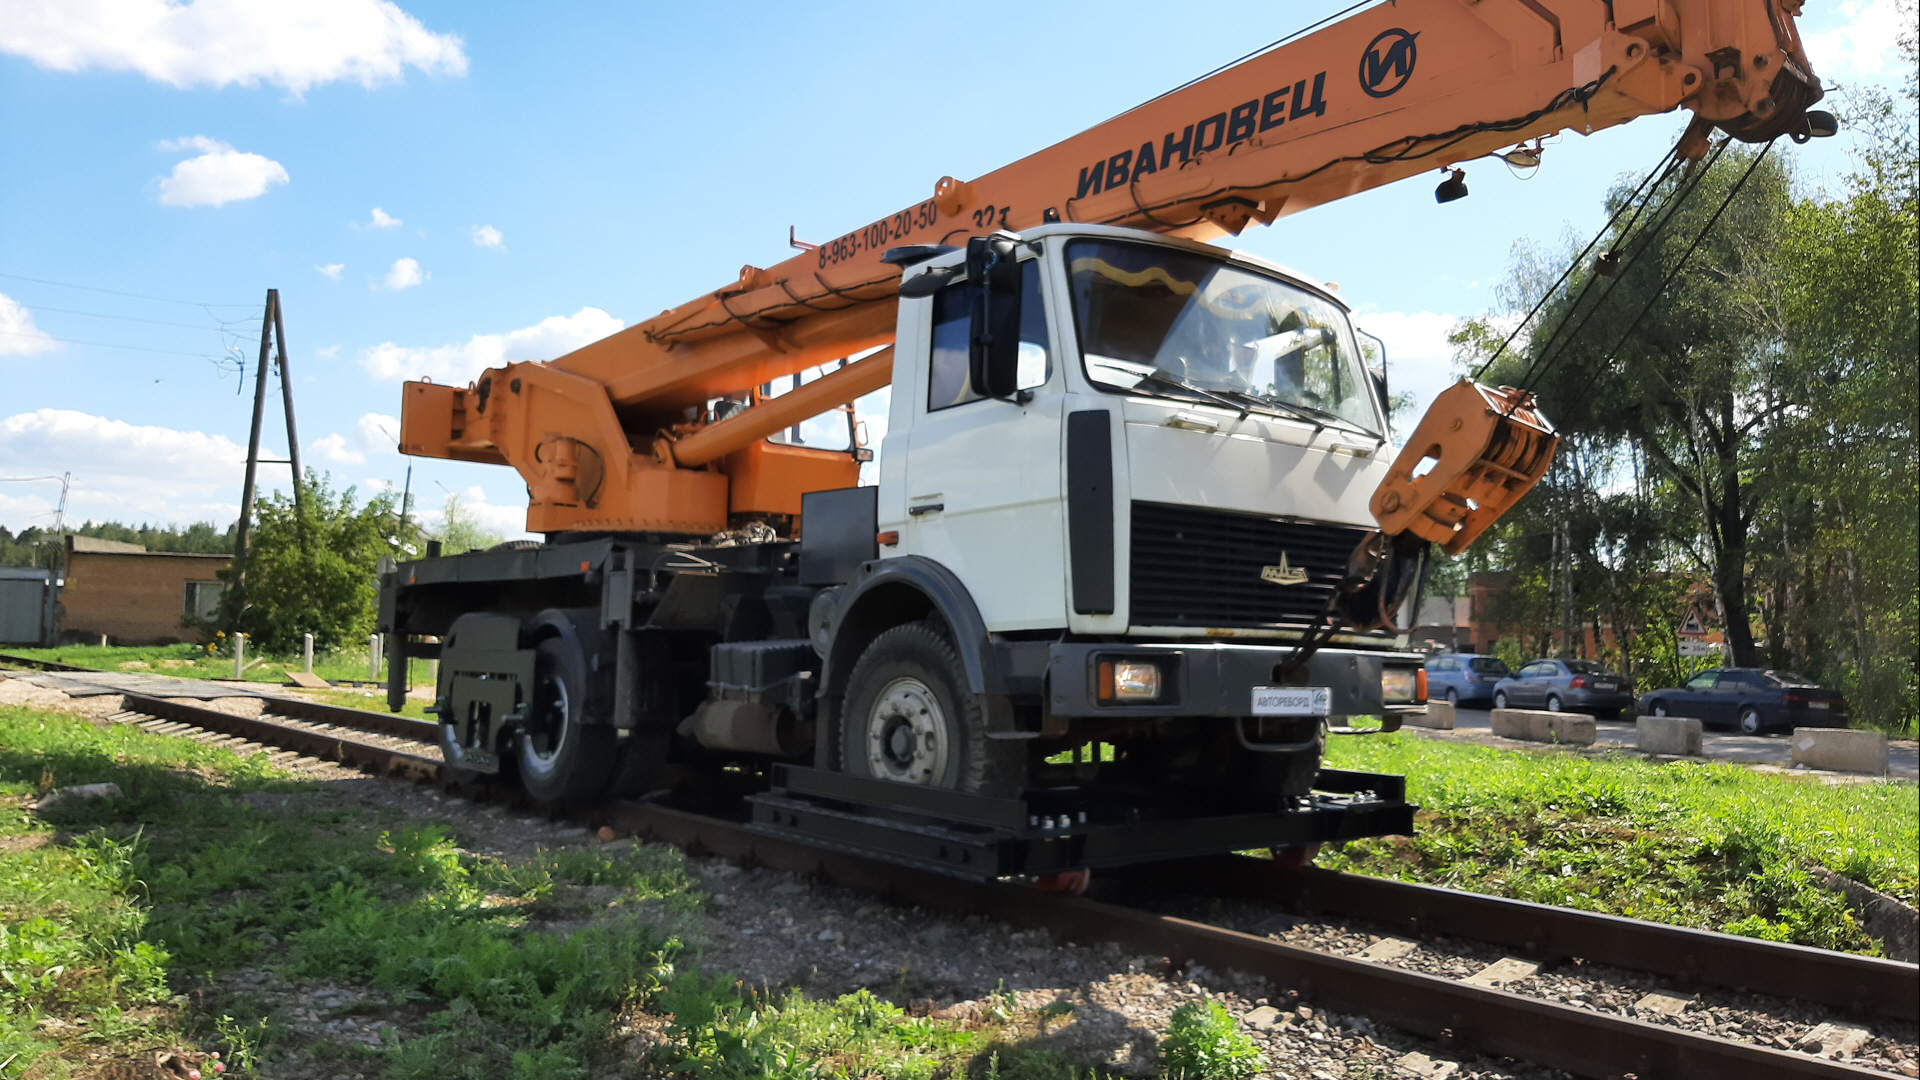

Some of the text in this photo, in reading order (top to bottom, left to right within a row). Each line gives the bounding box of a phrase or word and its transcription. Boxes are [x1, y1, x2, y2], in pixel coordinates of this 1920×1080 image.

[1076, 71, 1328, 199] ИВАНОВЕЦ
[819, 200, 938, 269] 8-963-100-20-50
[1257, 696, 1310, 708] АВТОРЕБОРД
